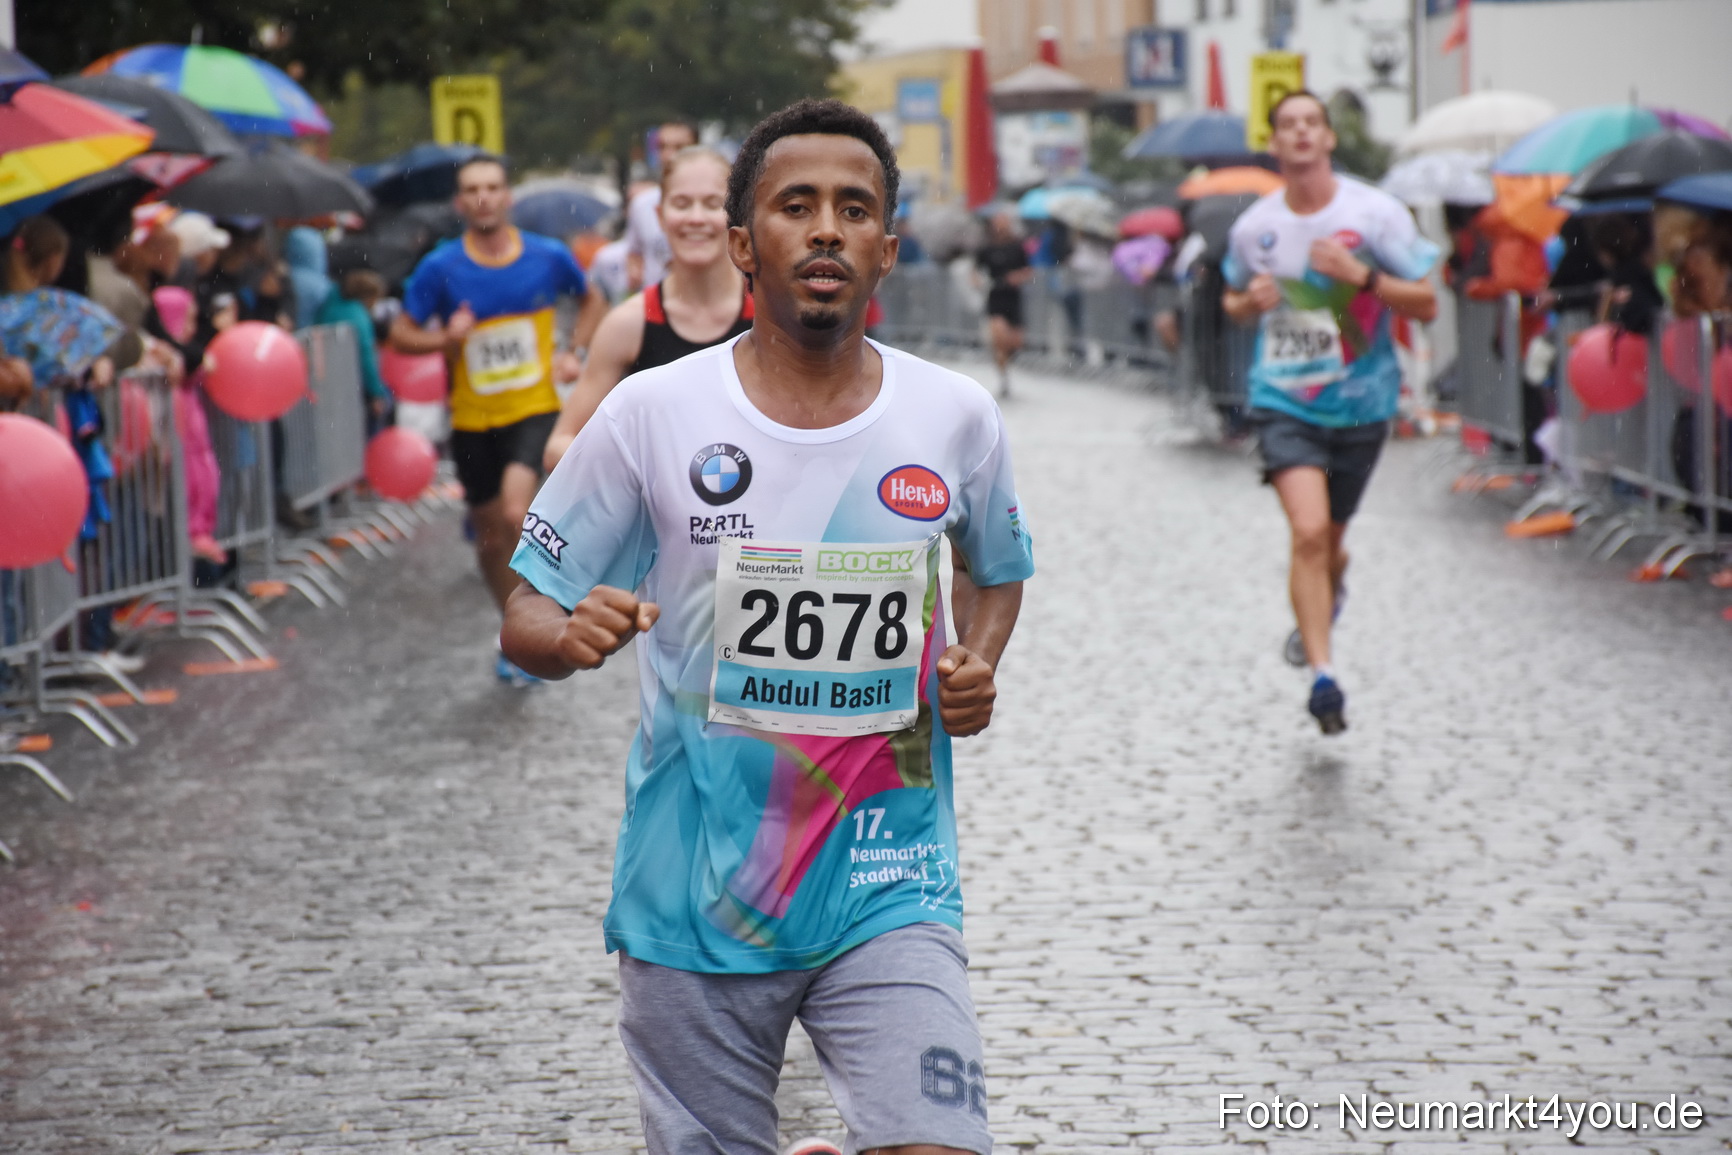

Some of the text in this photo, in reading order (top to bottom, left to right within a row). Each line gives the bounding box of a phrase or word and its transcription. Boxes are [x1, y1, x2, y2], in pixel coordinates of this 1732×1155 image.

[694, 444, 747, 464] BMW
[891, 478, 945, 507] Hervis
[690, 513, 754, 532] PARTL
[537, 550, 560, 570] concepts
[736, 562, 804, 574] NeuerMarkt
[817, 549, 914, 573] BOCK
[816, 573, 848, 581] inspired
[884, 574, 914, 582] concepts
[737, 589, 908, 661] 2678
[740, 676, 892, 709] Abdul Basit
[853, 808, 893, 841] 17.
